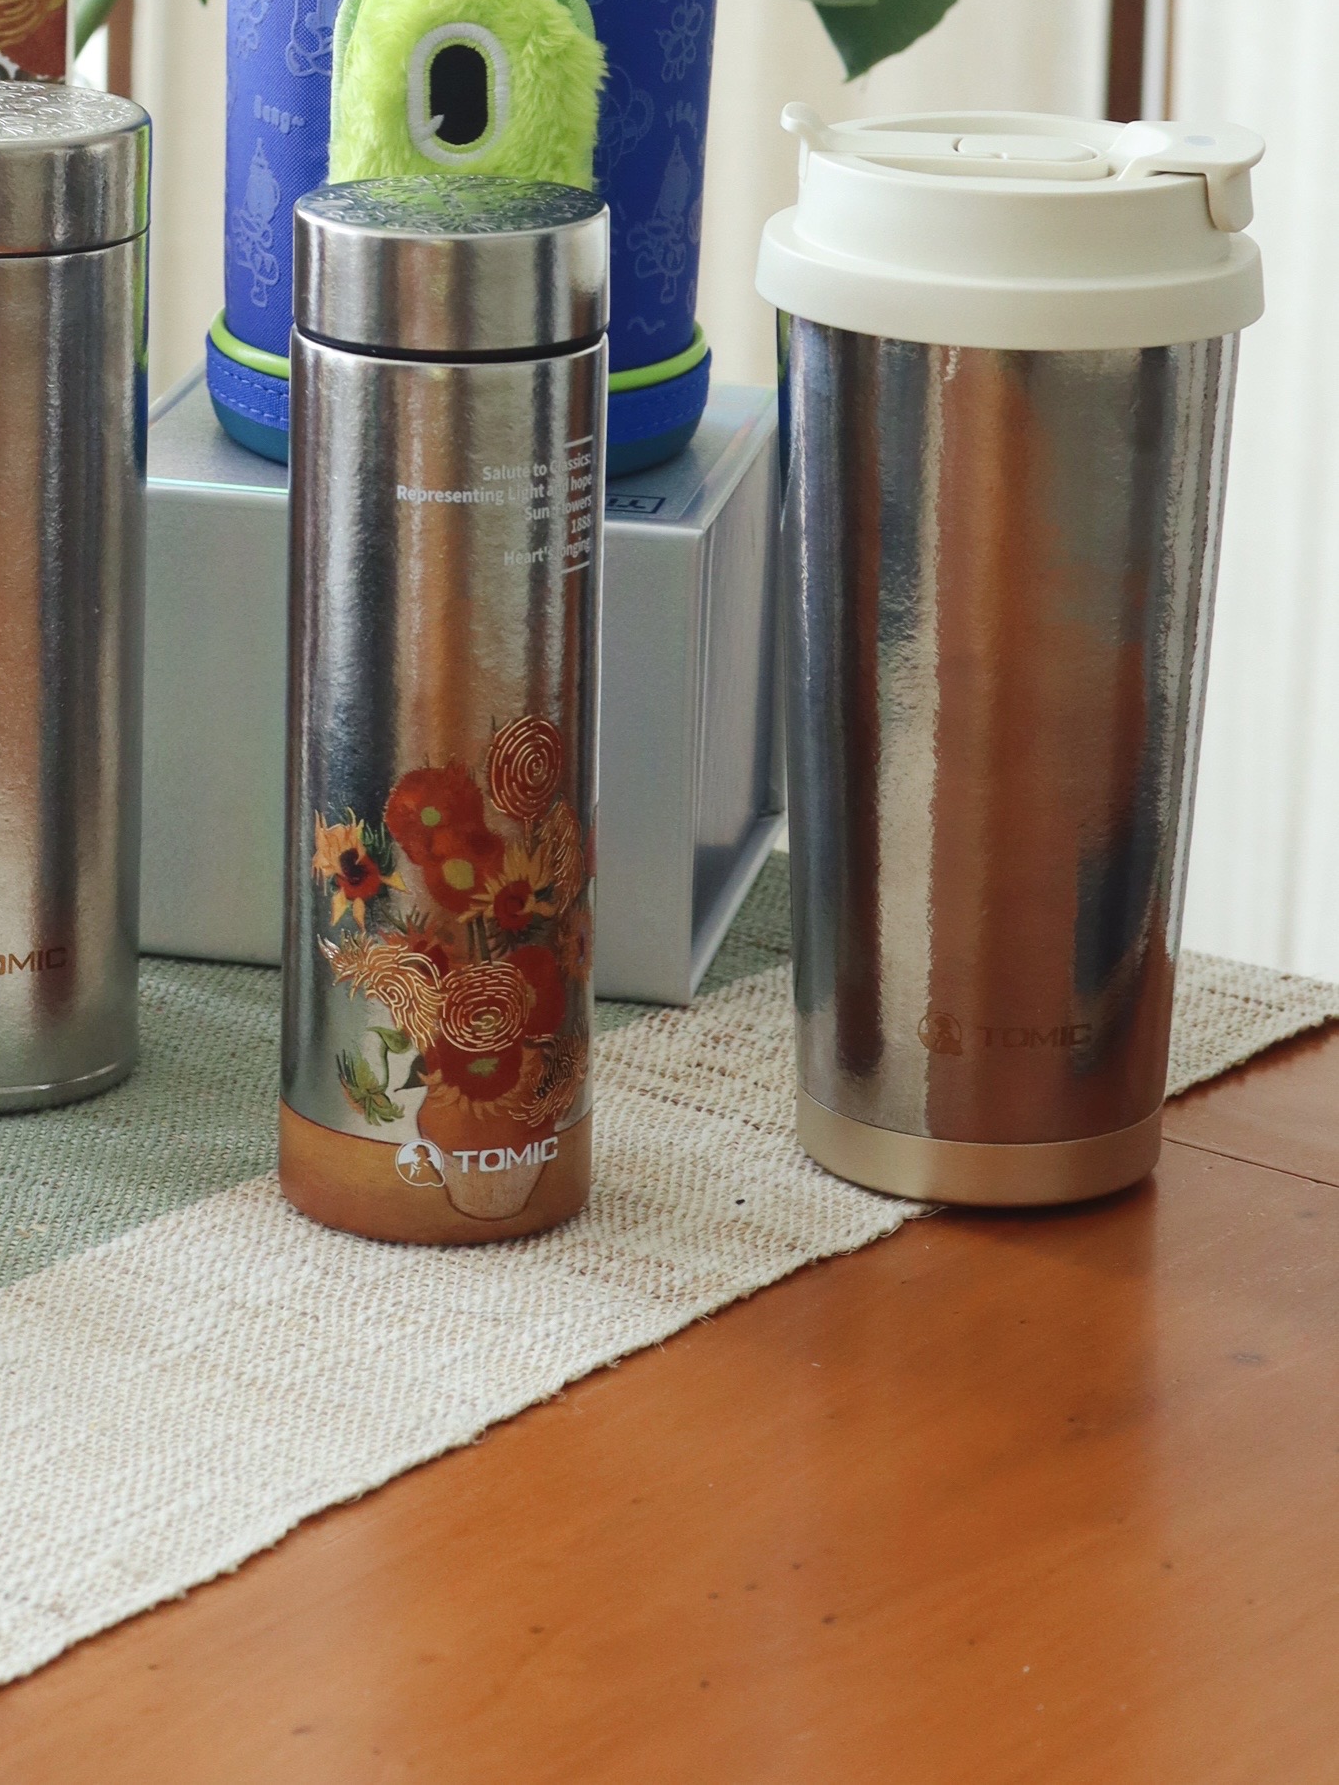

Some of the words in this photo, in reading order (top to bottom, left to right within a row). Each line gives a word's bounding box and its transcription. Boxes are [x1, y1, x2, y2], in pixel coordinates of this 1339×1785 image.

[482, 465, 531, 482] Salute
[533, 462, 548, 478] to
[396, 484, 505, 506] Representing
[508, 483, 545, 503] Light
[570, 472, 592, 493] hope
[524, 505, 550, 521] Sun
[503, 545, 554, 566] Heart's
[976, 1023, 1093, 1048] TOMIC
[452, 1135, 559, 1174] TOMIC
